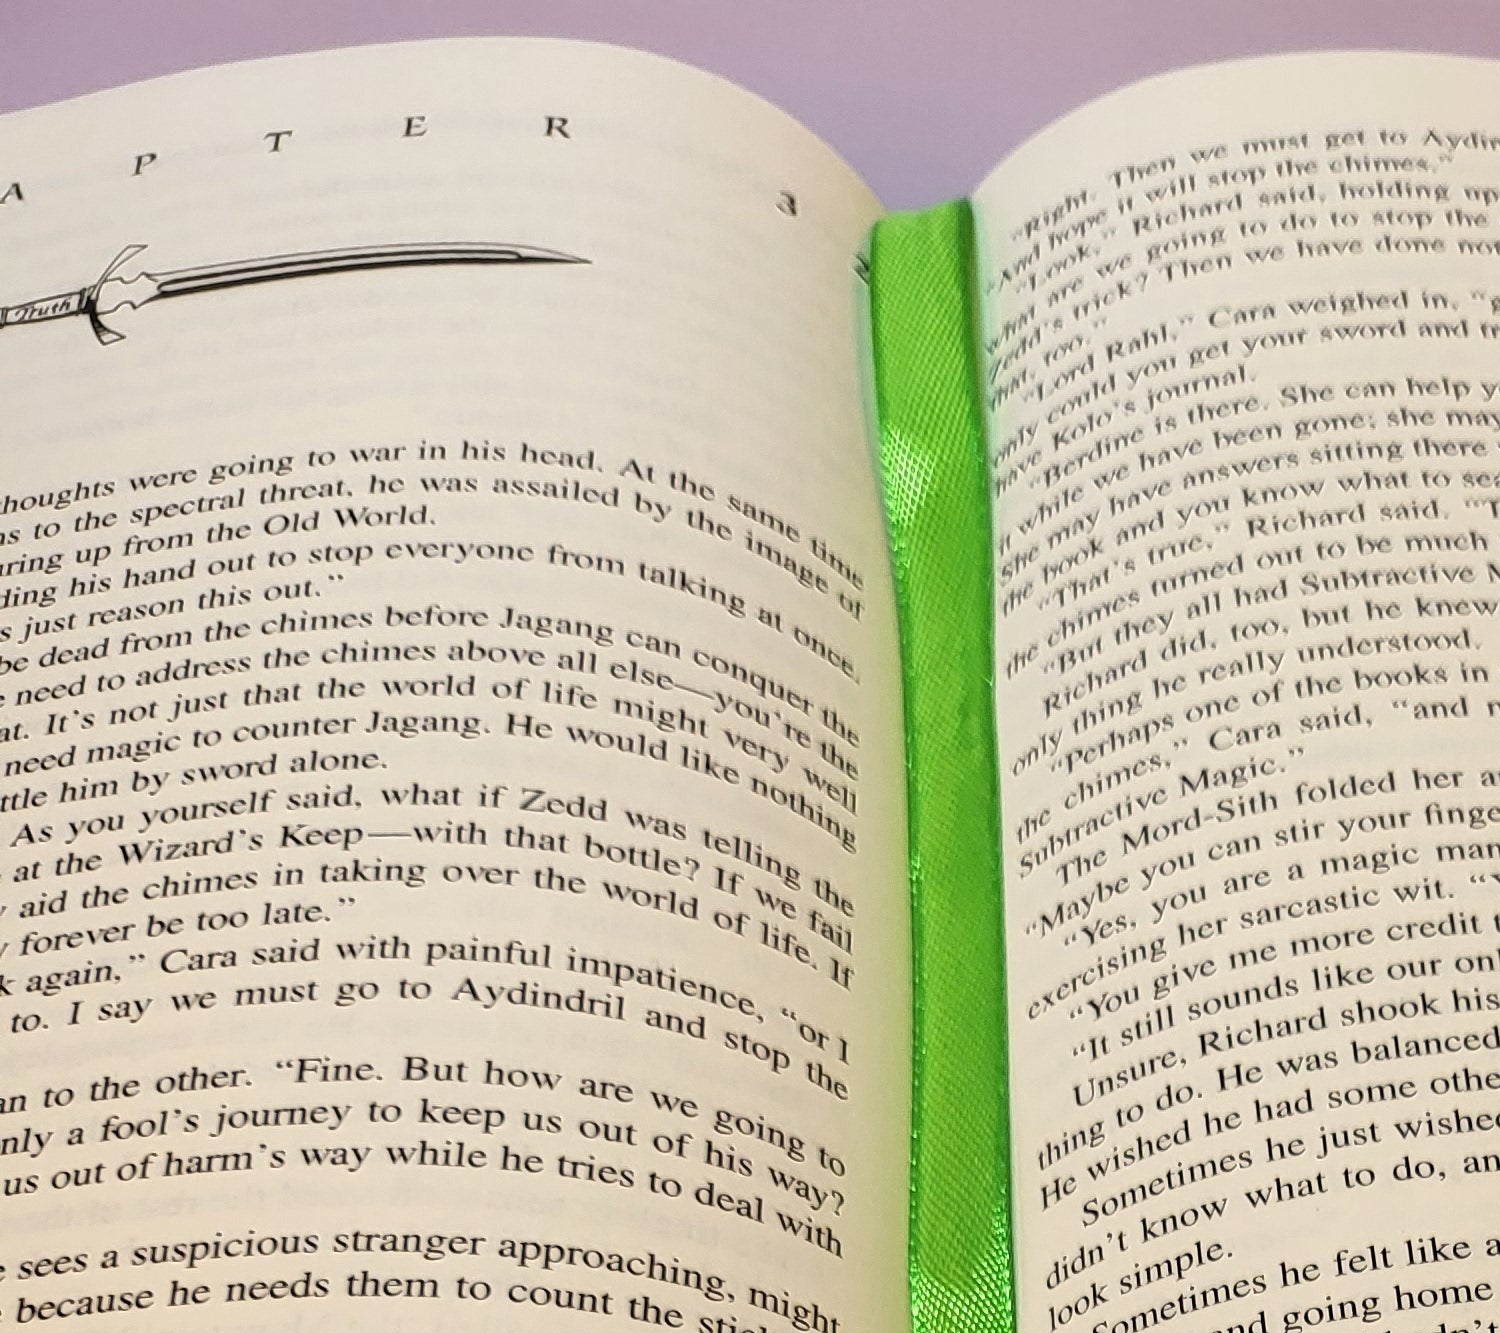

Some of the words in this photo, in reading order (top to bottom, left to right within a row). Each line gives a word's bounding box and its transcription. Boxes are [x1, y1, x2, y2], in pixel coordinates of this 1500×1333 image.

[1207, 302, 1277, 327] Cara
[1287, 289, 1410, 316] weighed
[0, 482, 115, 515] houghts
[130, 470, 197, 491] were
[208, 455, 293, 485] going
[309, 451, 335, 467] to
[350, 447, 406, 462] war
[420, 440, 445, 460] in
[462, 440, 505, 460] his
[522, 442, 602, 472] head.
[620, 459, 653, 483] At
[670, 472, 715, 500] the
[728, 495, 800, 542] same
[811, 538, 863, 590] time
[10, 824, 53, 847] As
[65, 815, 124, 844] you
[138, 789, 276, 833] yourself
[381, 782, 460, 806] what
[480, 784, 508, 808] if
[520, 788, 607, 821] Zedd
[625, 811, 686, 840] was
[704, 830, 800, 890] telling
[814, 878, 853, 917] the
[160, 949, 236, 973] Cara
[252, 938, 320, 965] said
[336, 935, 410, 959] with
[426, 937, 550, 968] painful
[567, 948, 763, 1023] impatience,
[782, 1008, 829, 1050] “or
[839, 1038, 848, 1064] I
[1154, 960, 1216, 1000] give
[1229, 945, 1277, 969] me
[1291, 928, 1374, 956] more
[1387, 912, 1482, 941] credit
[1279, 1262, 1320, 1288] he
[1334, 1245, 1393, 1277] felt
[1405, 1236, 1471, 1266] like
